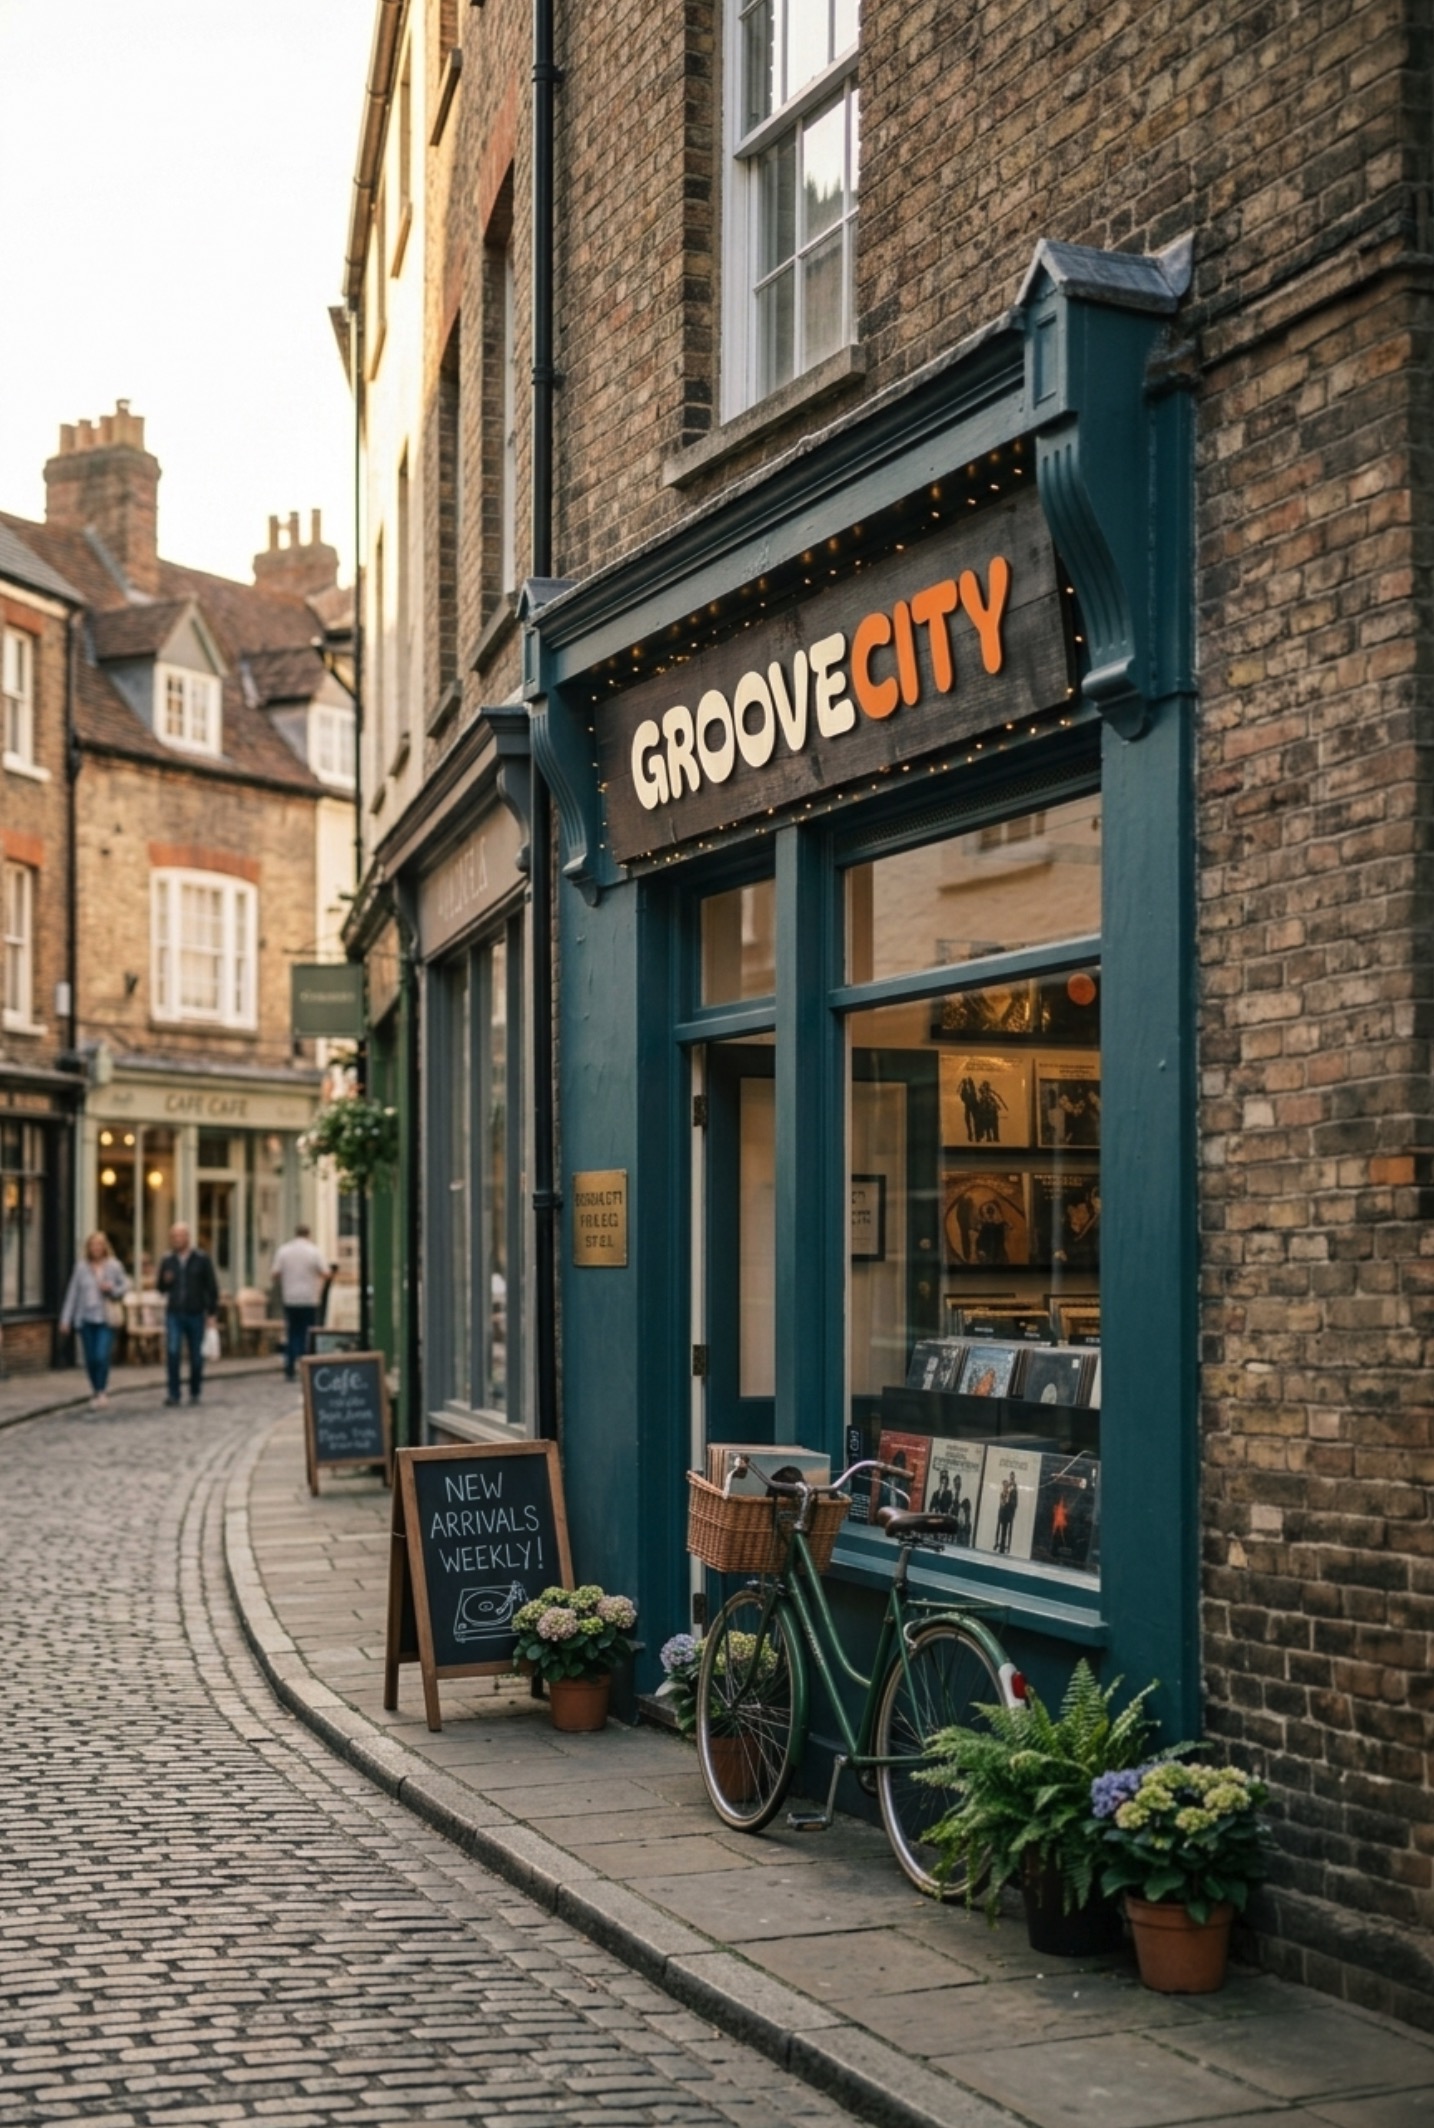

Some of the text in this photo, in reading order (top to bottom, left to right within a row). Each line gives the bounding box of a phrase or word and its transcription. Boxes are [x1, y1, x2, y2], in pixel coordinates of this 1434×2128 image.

[445, 1472, 503, 1502] NEW
[430, 1505, 540, 1539] ARRIVALS
[438, 1536, 544, 1573] WEEKLY!
